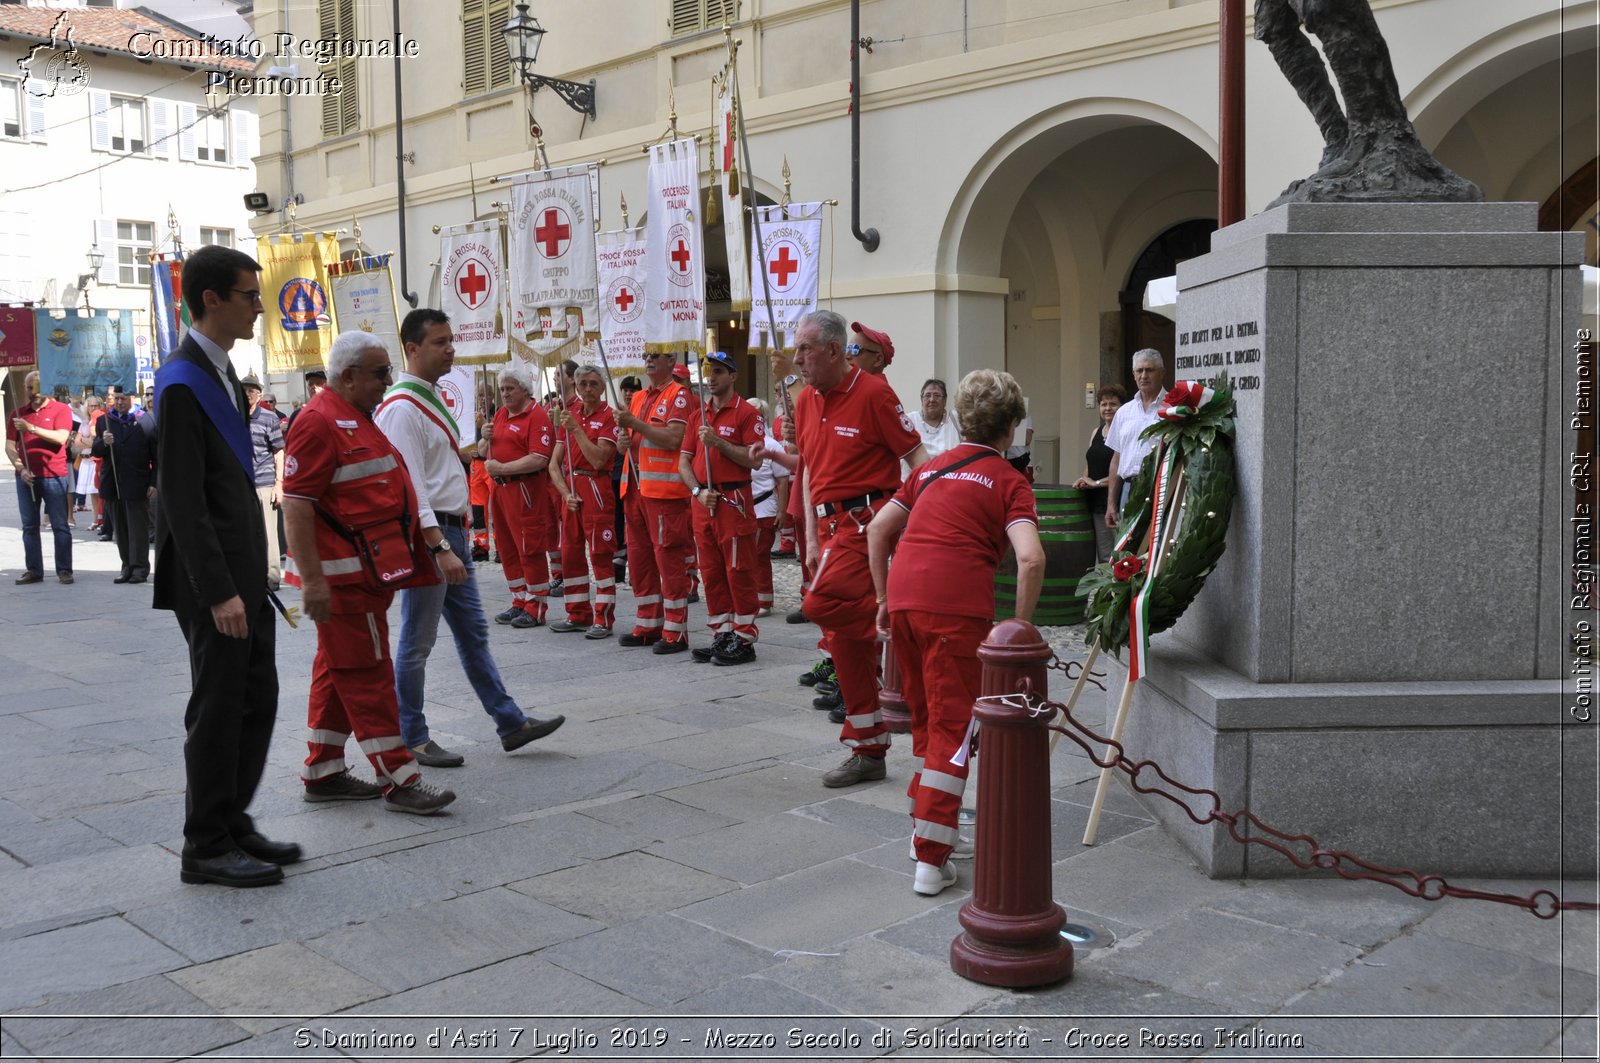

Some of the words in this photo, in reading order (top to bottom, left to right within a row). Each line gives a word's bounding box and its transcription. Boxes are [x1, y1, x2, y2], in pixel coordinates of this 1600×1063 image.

[518, 200, 535, 230] CROCE
[534, 188, 556, 204] ROSSA
[559, 188, 585, 224] ITALIANA
[773, 227, 793, 240] ROSSA
[455, 243, 477, 257] ROSSA
[599, 251, 621, 261] CROCE
[623, 248, 646, 257] ROSSA
[607, 260, 637, 269] ITALIANA
[542, 266, 569, 279] GRUPPO
[521, 288, 568, 304] VILLAFRANCA
[785, 298, 811, 306] LOCALE
[1211, 327, 1223, 341] PER
[1225, 324, 1234, 339] LA
[1237, 321, 1258, 337] PATRIA
[605, 337, 646, 345] CASTELNUOV
[1195, 355, 1202, 368] LA
[1203, 352, 1224, 367] GLORIA
[1226, 351, 1232, 365] IL
[1239, 376, 1260, 390] GRIDO
[958, 472, 994, 489] ITALIANA
